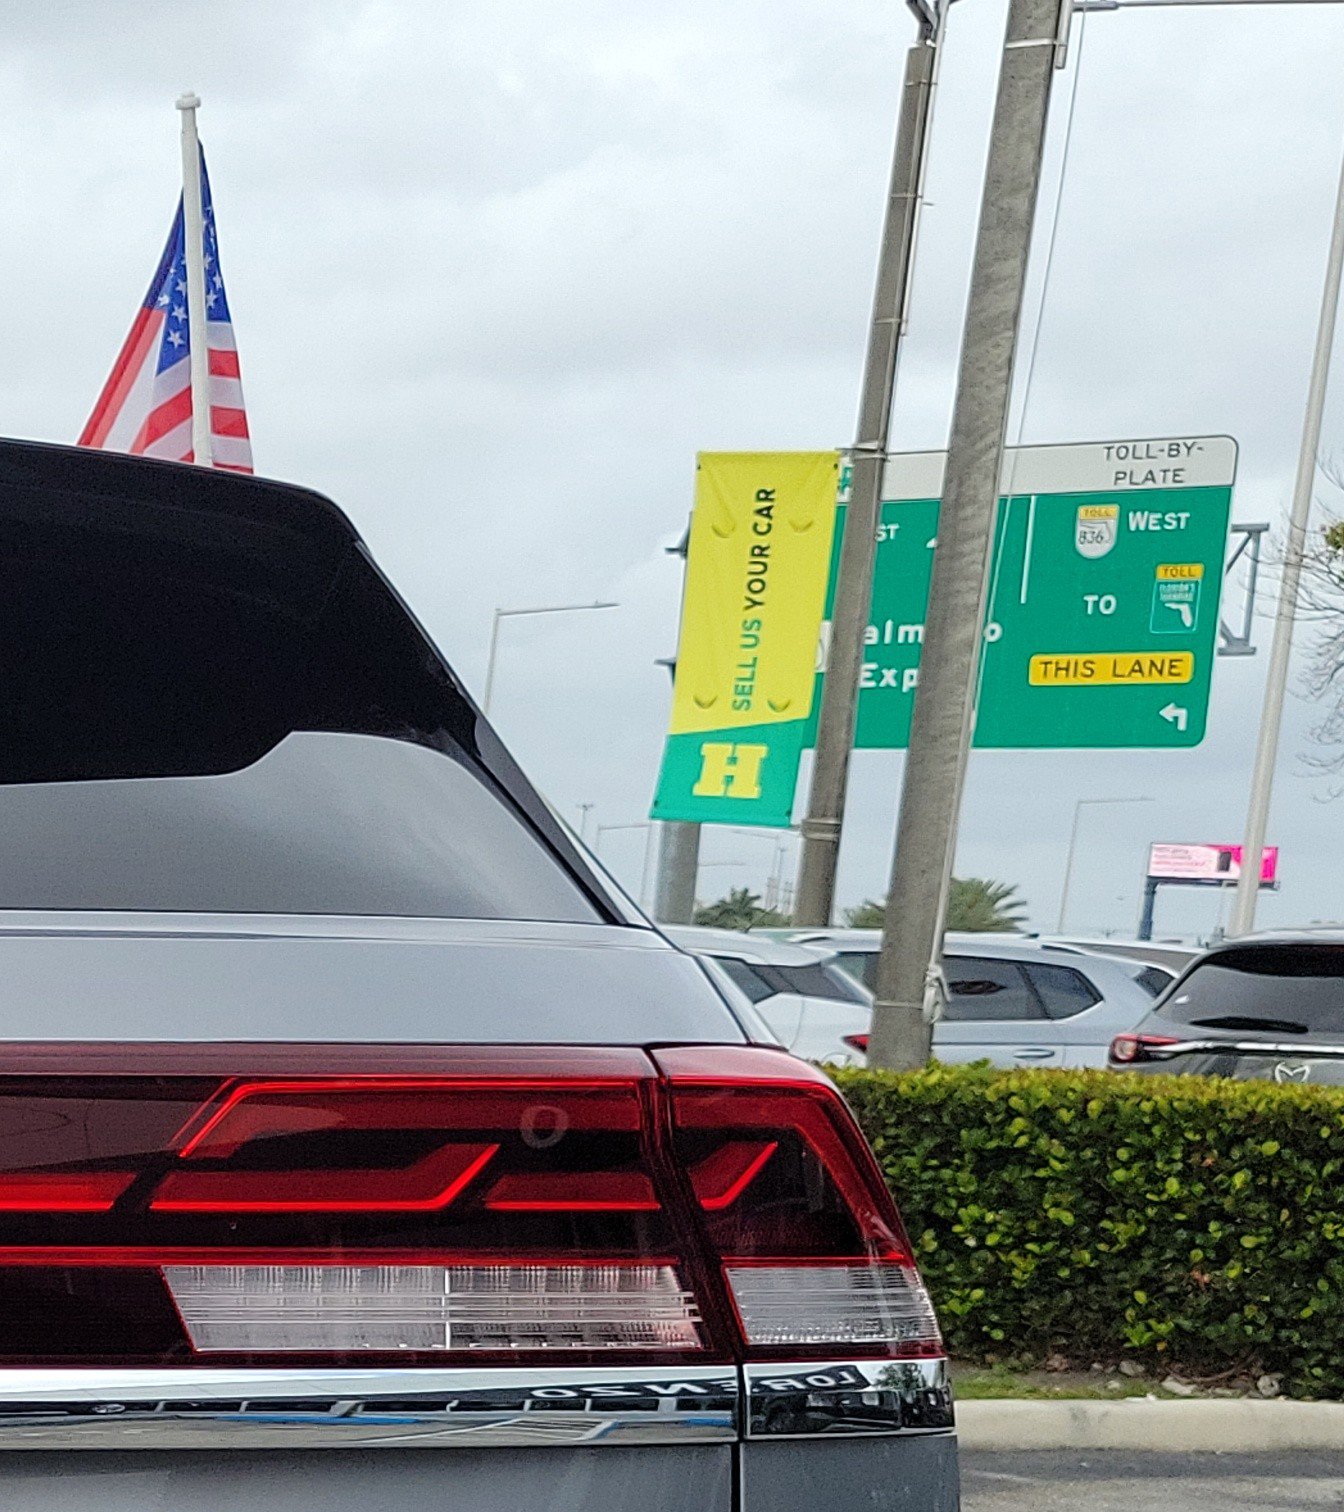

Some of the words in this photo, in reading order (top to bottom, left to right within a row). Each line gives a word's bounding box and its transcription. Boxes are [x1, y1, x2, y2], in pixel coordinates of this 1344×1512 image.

[1104, 441, 1204, 461] TOLL-BY-
[1113, 468, 1186, 486] PLATE
[753, 487, 776, 536] CAR
[1128, 511, 1190, 531] WEST
[1078, 530, 1104, 545] 836
[744, 544, 771, 611] YOUR
[1162, 566, 1196, 578] TOLL
[1083, 594, 1117, 615] TO
[740, 618, 762, 650] US
[1040, 660, 1096, 679] THIS
[1112, 658, 1184, 679] LANE
[732, 657, 758, 711] SELL
[693, 743, 769, 799] H
